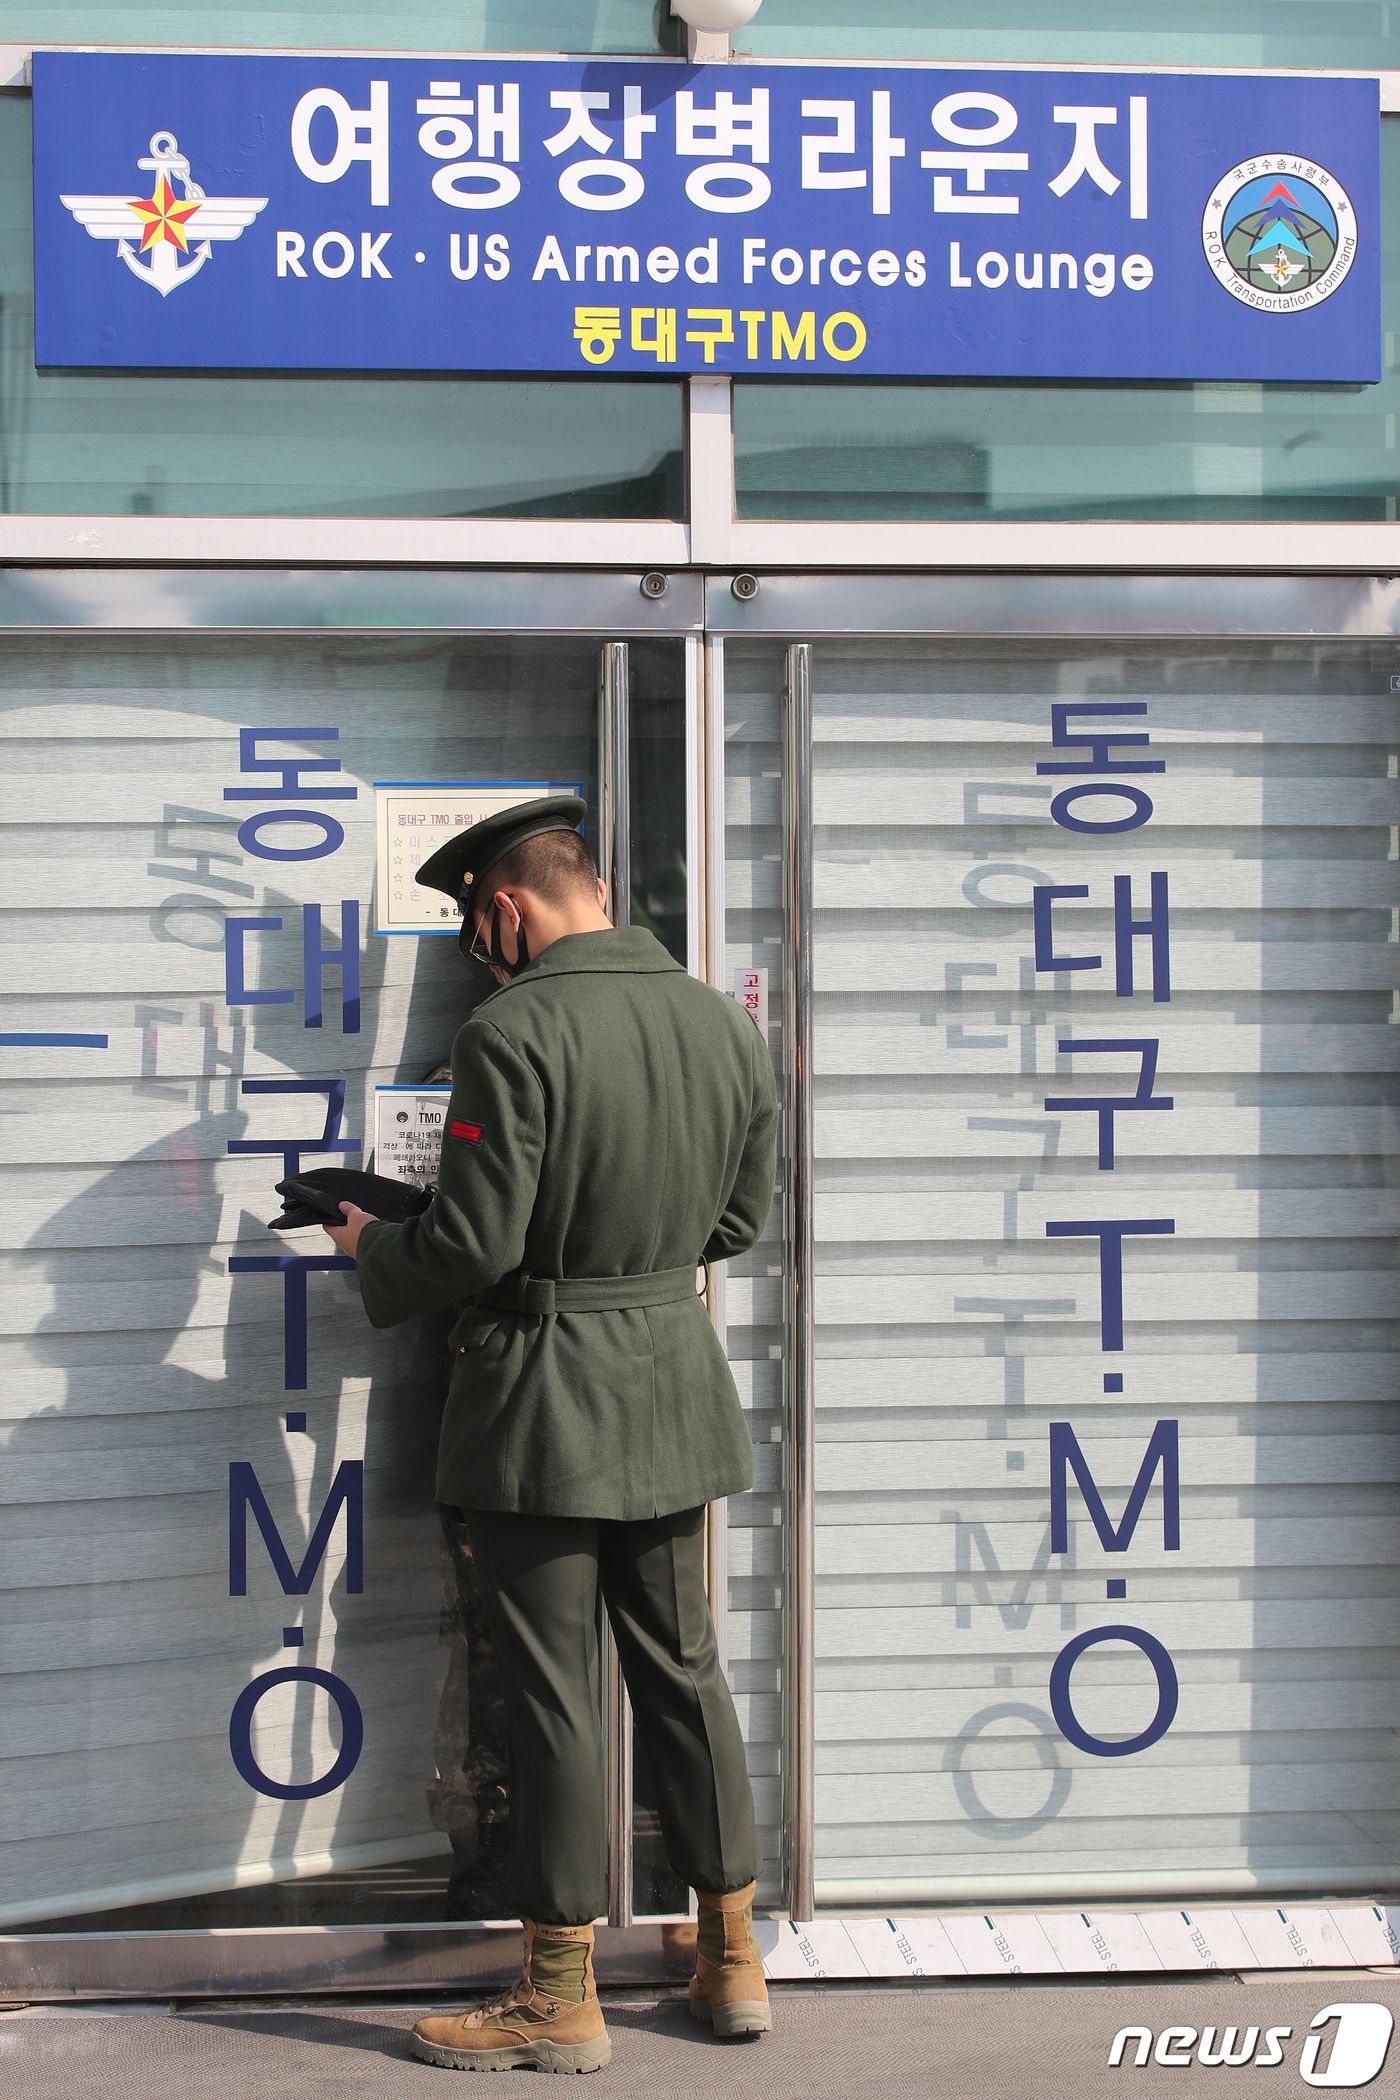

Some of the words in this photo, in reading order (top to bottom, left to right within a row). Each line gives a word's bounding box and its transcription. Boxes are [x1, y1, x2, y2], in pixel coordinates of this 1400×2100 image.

[290, 81, 1148, 219] 여행장병라운지
[1232, 159, 1330, 186] 국군수송사령부
[276, 231, 394, 279] ROK
[449, 233, 511, 281] US
[531, 234, 719, 284] Armed
[742, 237, 927, 288] Forces
[949, 241, 1154, 298] Lounge
[1205, 231, 1227, 269] ROK
[1226, 272, 1314, 309] Transportation
[1315, 236, 1356, 295] Command
[573, 306, 867, 365] 동대구TMO
[398, 814, 426, 825] 동대구
[430, 814, 450, 825] TMO
[454, 813, 473, 825] 출입
[418, 1112, 442, 1124] TMO
[798, 1934, 820, 1967] STEEL
[895, 1931, 918, 1966] STEEL
[992, 1930, 1015, 1963] STEEL
[1091, 1926, 1112, 1961] STEEL
[1190, 1924, 1211, 1958] STEEL
[1286, 1922, 1308, 1957] STEEL
